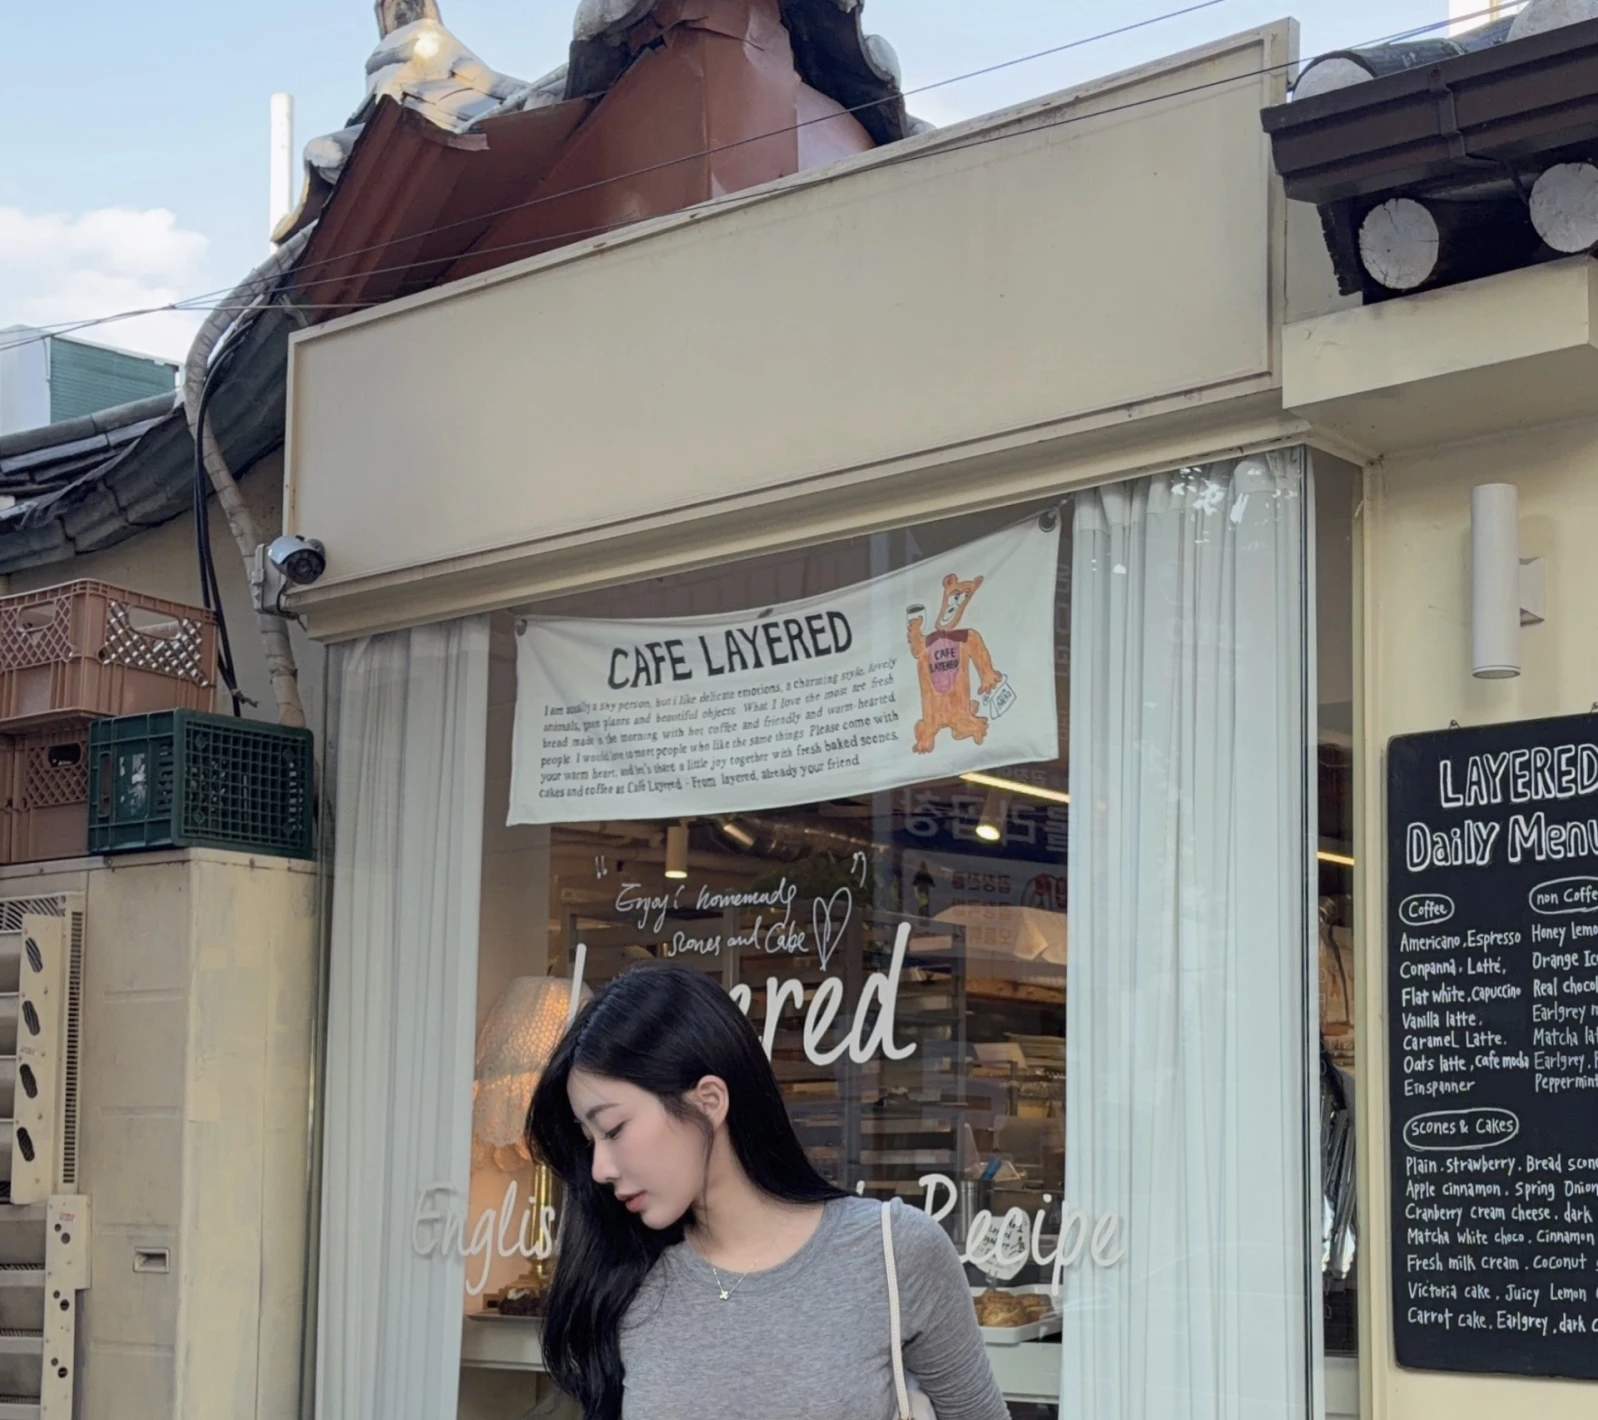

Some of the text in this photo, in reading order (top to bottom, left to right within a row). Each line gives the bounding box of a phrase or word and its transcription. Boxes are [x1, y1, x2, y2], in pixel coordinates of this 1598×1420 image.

[607, 611, 853, 690] CAFE LAYERED
[934, 647, 956, 661] CAFE
[930, 659, 960, 673] LAYERED
[544, 705, 549, 716] I
[550, 707, 564, 716] am
[600, 702, 616, 712] shy
[655, 697, 671, 708] but
[679, 693, 697, 705] like
[700, 690, 735, 703] delicate
[786, 682, 792, 691] a
[793, 676, 838, 689] charming
[868, 657, 898, 673] lovely
[543, 720, 581, 732] animals,
[634, 713, 652, 725] and
[656, 709, 699, 724] beautiful
[743, 701, 768, 712] What
[772, 698, 777, 710] I
[780, 697, 802, 709] love
[805, 692, 820, 703] the
[824, 687, 848, 700] most
[852, 682, 866, 693] are
[871, 673, 894, 689] fresh
[542, 736, 568, 748] bread
[620, 731, 659, 743] morning
[662, 727, 684, 739] with
[688, 726, 704, 737] hot
[708, 721, 737, 735] coffee
[742, 718, 760, 730] and
[763, 711, 801, 728] friendly
[805, 706, 823, 720] and
[576, 752, 581, 763] I
[656, 743, 687, 760] people
[690, 740, 710, 752] who
[713, 738, 730, 751] like
[732, 737, 747, 749] the
[749, 733, 773, 746] same
[809, 722, 841, 738] Please
[842, 716, 871, 731] come
[873, 709, 899, 725] with
[540, 772, 561, 785] your
[563, 771, 589, 781] warm
[653, 762, 676, 774] share
[679, 763, 685, 772] a
[687, 757, 708, 771] little
[710, 758, 727, 771] joy
[730, 751, 769, 768] together
[771, 746, 793, 760] with
[796, 742, 823, 757] fresh
[824, 733, 859, 752] baked
[538, 786, 565, 798] cakes
[566, 784, 584, 798] and
[585, 782, 614, 795] coffee
[615, 785, 625, 795] at
[648, 775, 684, 793] Layered
[691, 775, 717, 789] From
[761, 764, 799, 780] already
[800, 762, 825, 778] your
[1439, 743, 1598, 808] LAYERED
[1406, 819, 1501, 872] Daily
[1408, 900, 1448, 918] Coffee
[1536, 893, 1559, 905] non
[726, 915, 761, 950] and
[1467, 929, 1522, 953] Espresso
[1531, 923, 1566, 947] Honey
[1532, 951, 1579, 971] Orange
[1401, 986, 1430, 1007] Flat
[1533, 976, 1558, 998] Real
[1402, 1010, 1440, 1030] Vanilla
[1532, 1000, 1586, 1025] Earlgrey
[1533, 1026, 1579, 1047] Matcha
[1403, 1054, 1435, 1074] Oats
[1404, 1078, 1476, 1098] Einspanner
[1459, 1118, 1469, 1134] &
[1475, 1117, 1514, 1135] Cakes
[1526, 1153, 1562, 1174] Bread
[1405, 1179, 1436, 1200] Apple
[1405, 1202, 1463, 1227] Cranberry
[1564, 1200, 1594, 1224] dark
[918, 1173, 1126, 1297] Recipe
[1407, 1226, 1451, 1246] Matcha
[1456, 1227, 1489, 1246] white
[1407, 1251, 1444, 1273] Fresh
[1448, 1253, 1477, 1272] milk
[1533, 1252, 1588, 1271] Coconut
[1407, 1280, 1458, 1300] Victoria
[1505, 1283, 1540, 1309] Juicy
[1550, 1282, 1588, 1303] Lemon
[1407, 1306, 1454, 1330] Carrot
[1558, 1312, 1587, 1334] dark
